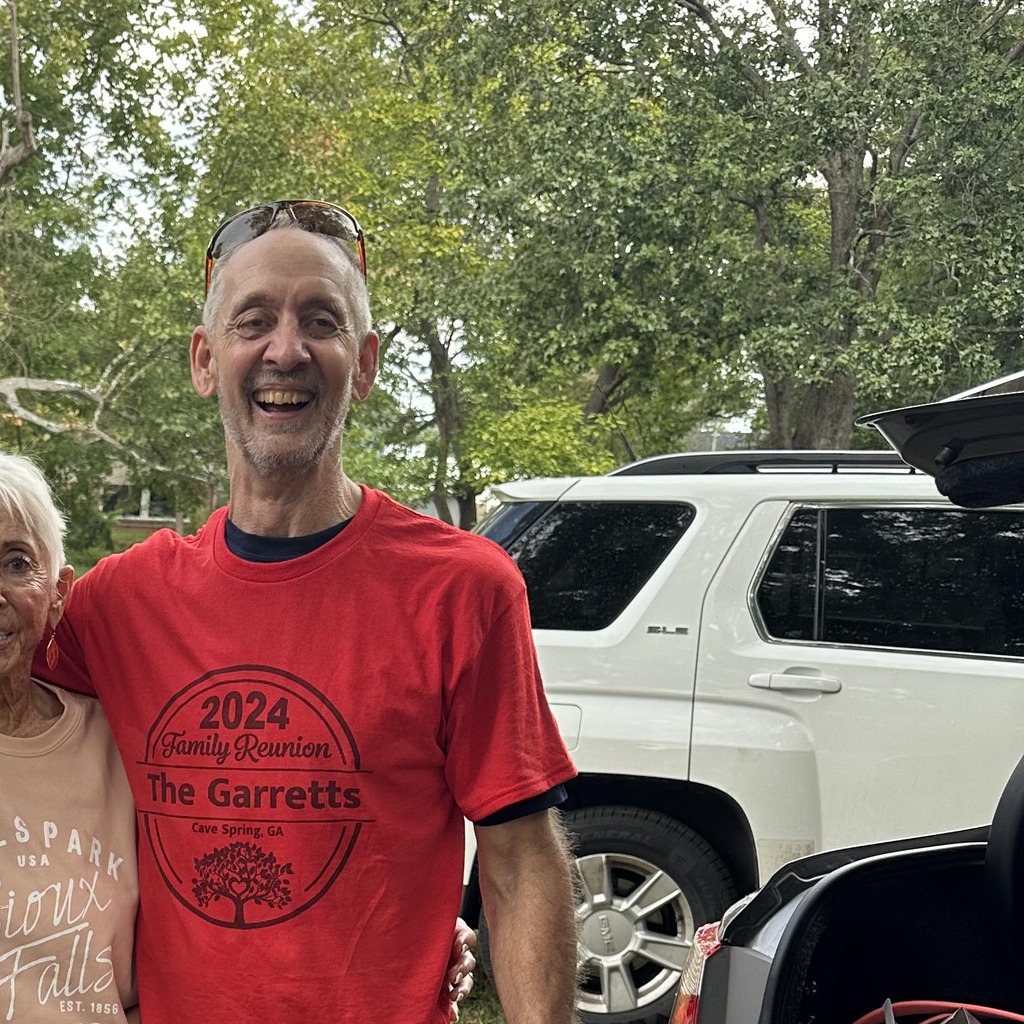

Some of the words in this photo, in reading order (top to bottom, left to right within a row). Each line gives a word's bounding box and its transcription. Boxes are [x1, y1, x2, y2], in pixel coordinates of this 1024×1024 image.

[199, 690, 290, 730] 2024
[161, 729, 230, 765] Family
[233, 733, 332, 763] Reunion
[147, 772, 196, 806] The
[207, 777, 362, 810] Garretts
[191, 821, 218, 834] Cave
[221, 822, 264, 839] Spring,
[267, 825, 284, 837] GA
[17, 853, 50, 867] USA
[43, 820, 124, 882] PARK
[598, 914, 616, 953] GMC
[59, 1000, 86, 1012] EST.
[90, 1001, 119, 1015] 1856
